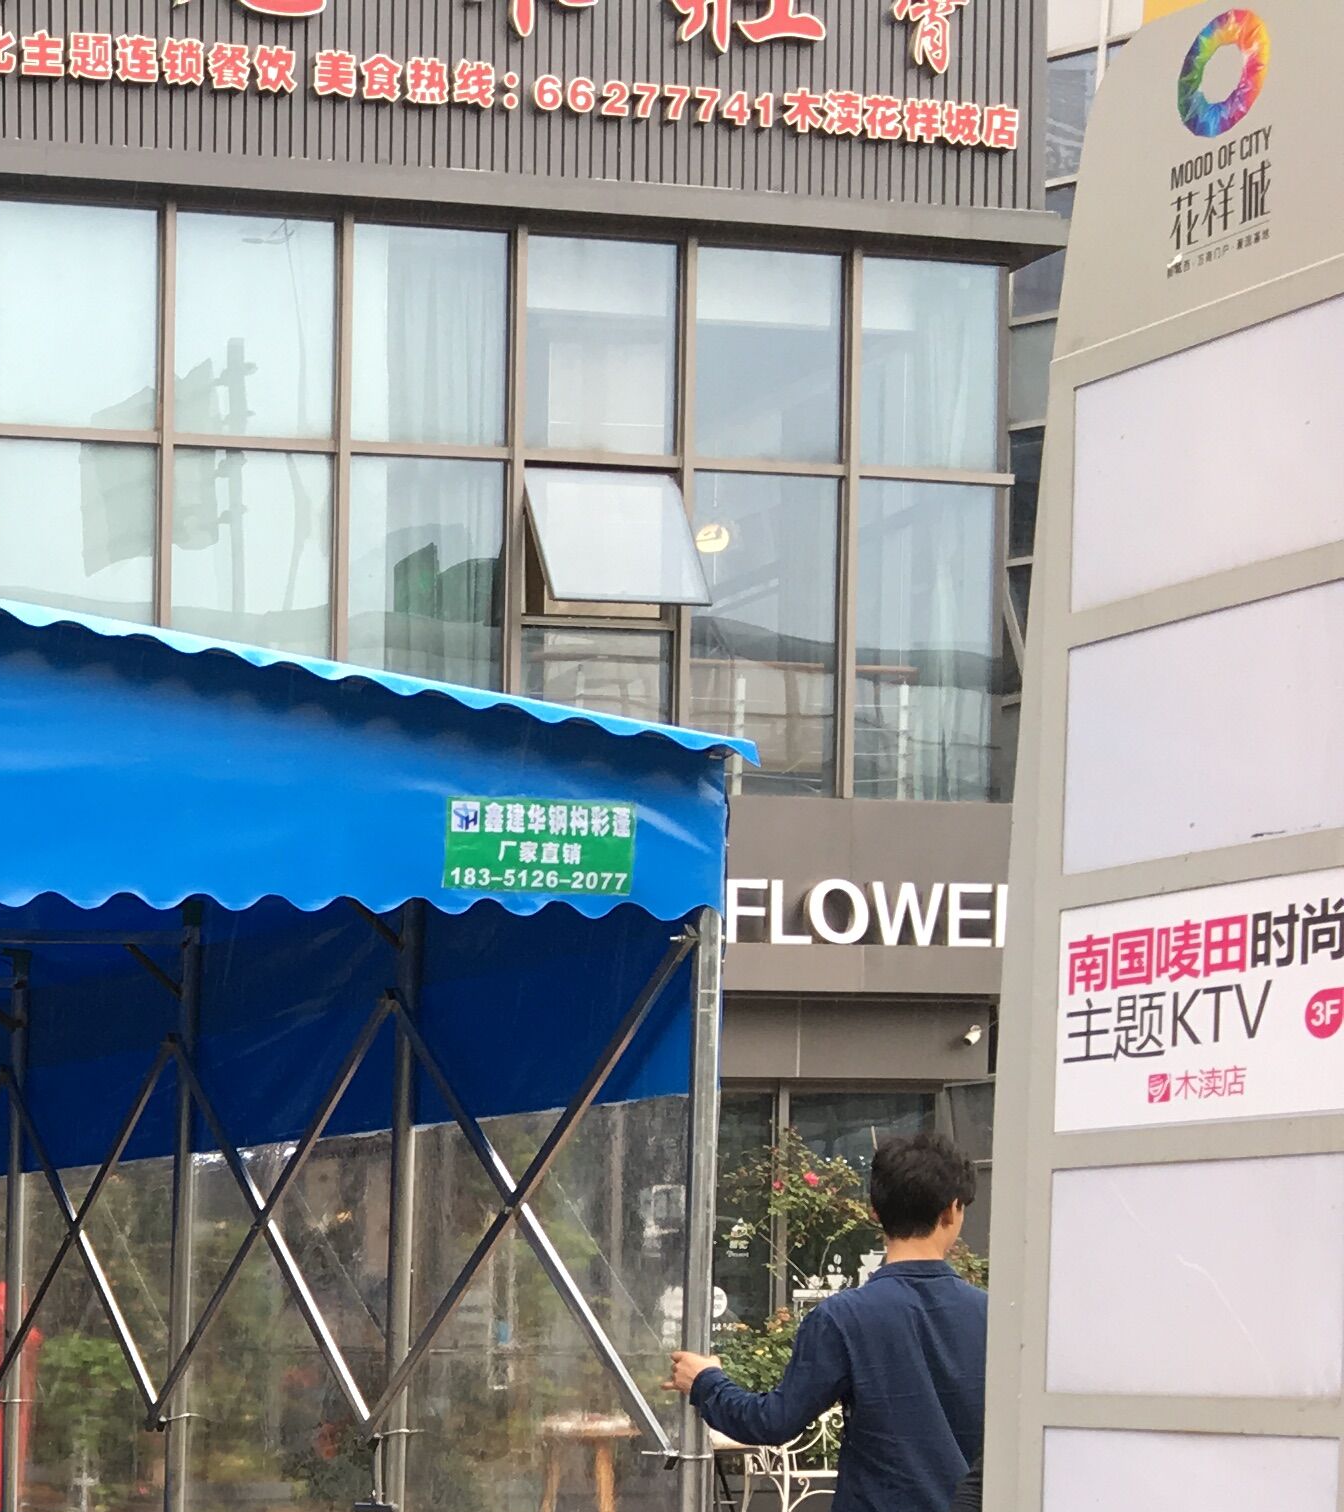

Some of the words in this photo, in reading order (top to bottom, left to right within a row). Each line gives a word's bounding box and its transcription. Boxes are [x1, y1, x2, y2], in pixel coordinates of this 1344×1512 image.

[1170, 151, 1214, 191] MOOD
[1218, 142, 1236, 170] OF
[1240, 125, 1272, 161] CITY
[1169, 159, 1273, 251] 花样城
[498, 840, 582, 865] 厂家直销
[450, 867, 628, 891] 183-5126-2077
[1063, 980, 1272, 1064] 主题KTV
[1310, 1000, 1340, 1030] 3F
[1174, 1064, 1248, 1101] 木渎店
